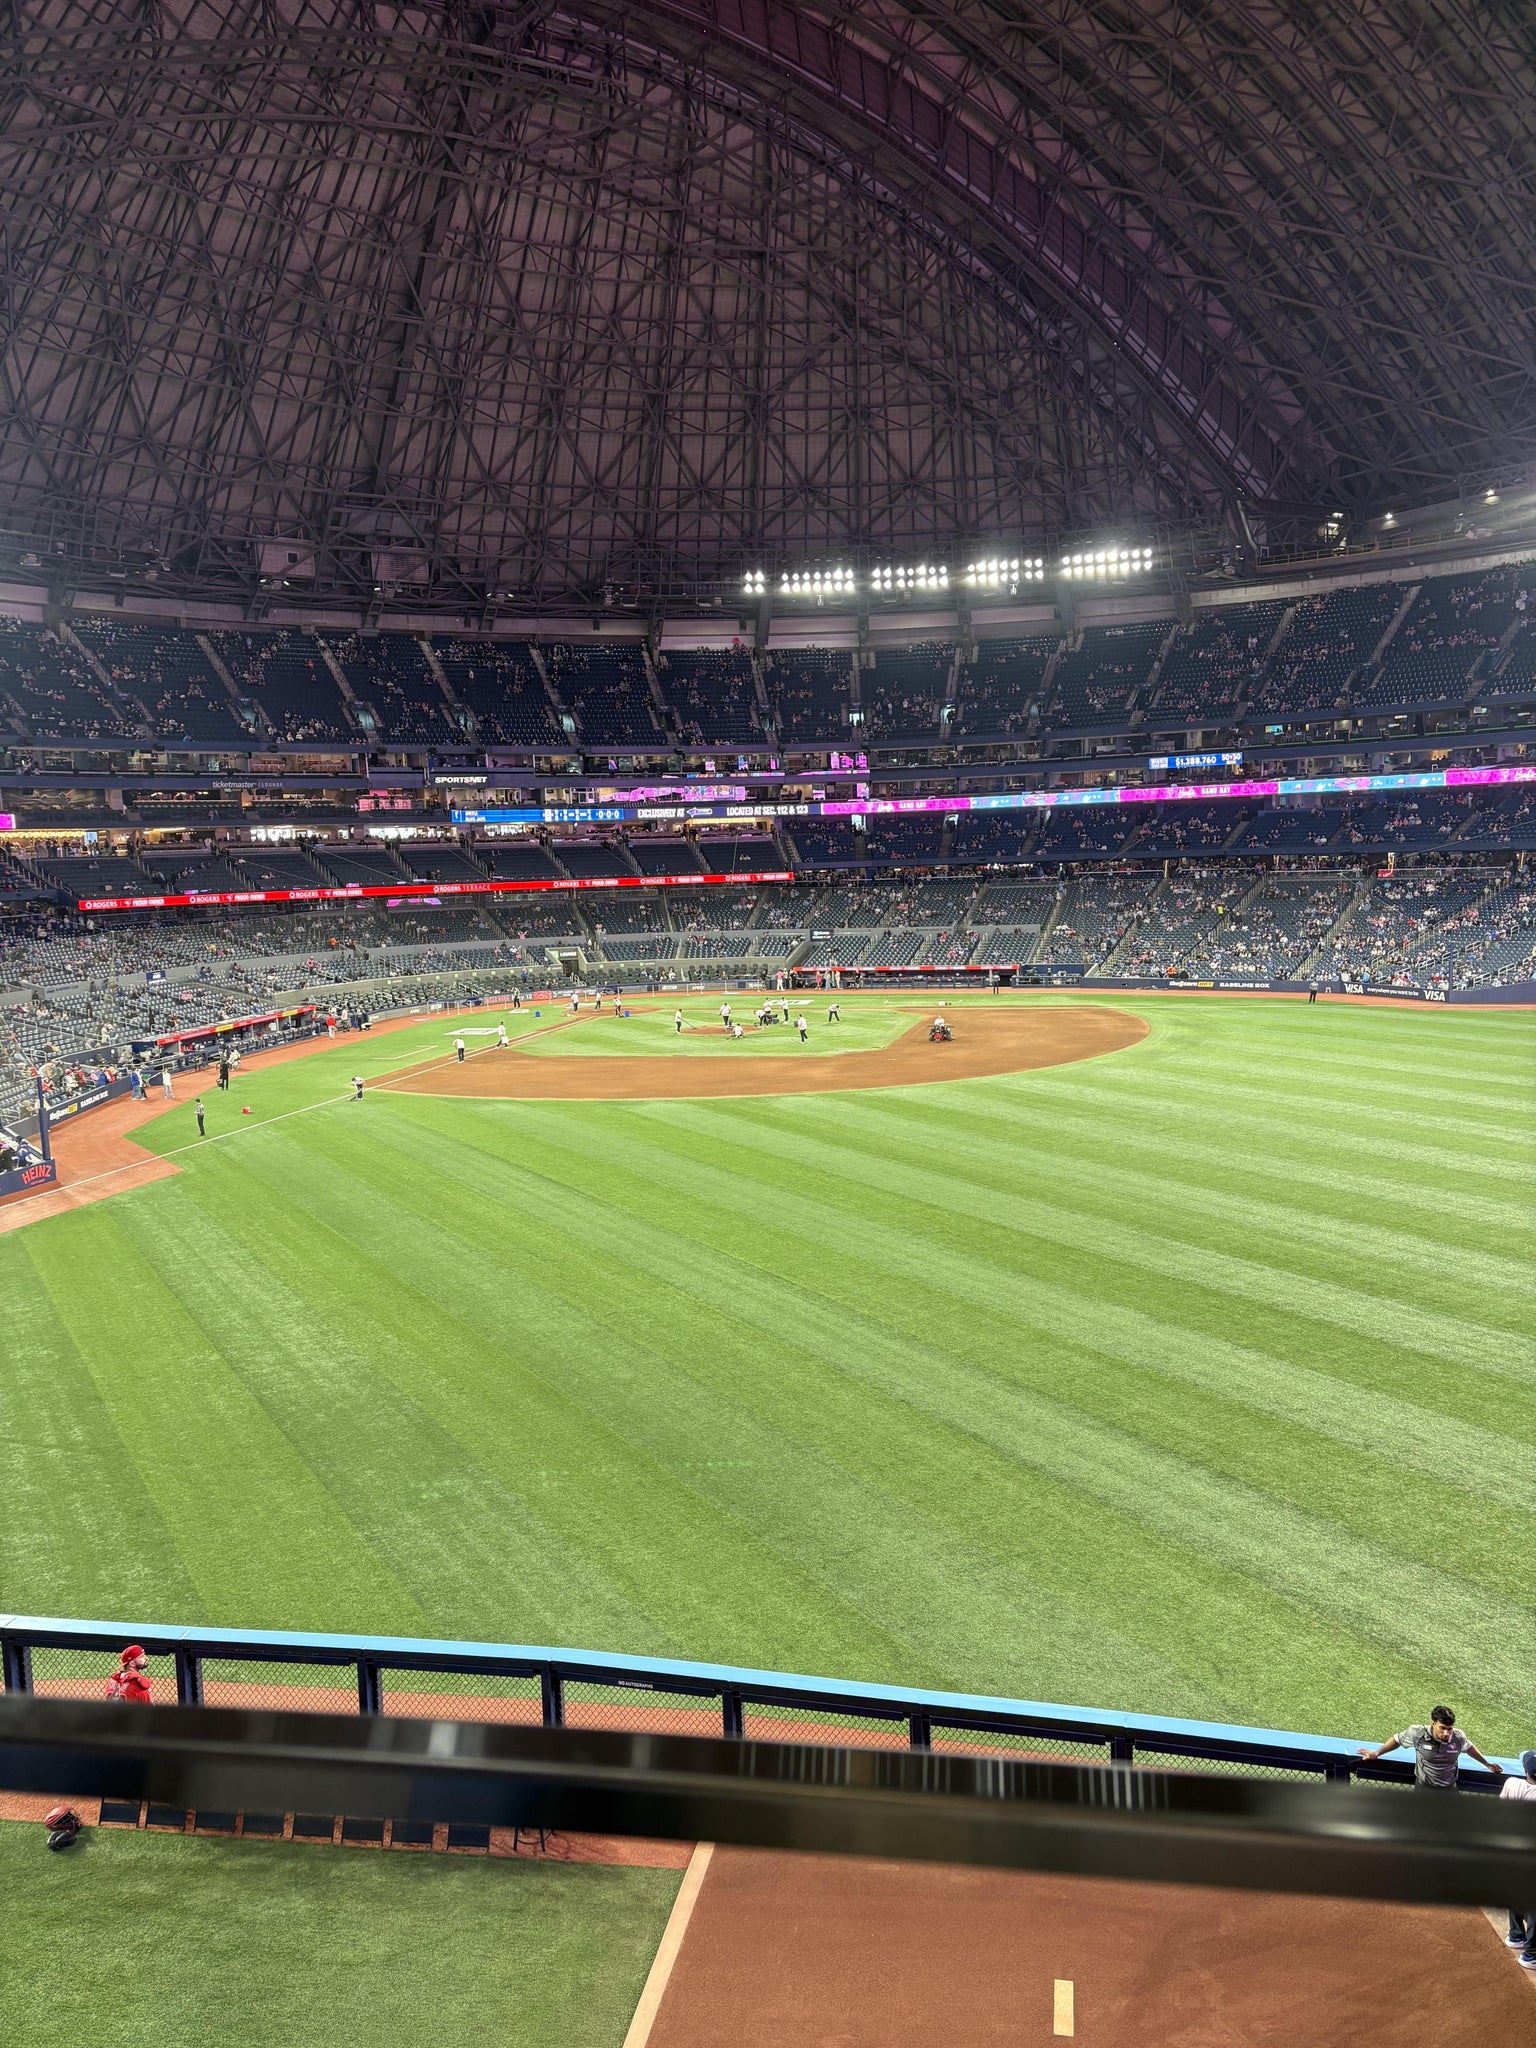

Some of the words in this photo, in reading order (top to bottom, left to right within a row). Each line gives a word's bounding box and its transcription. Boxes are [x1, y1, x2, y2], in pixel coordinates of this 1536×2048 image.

[212, 780, 255, 788] ticketmaster
[435, 776, 488, 784] SPORTSNET
[637, 808, 676, 818] EXCLUSIVELY
[677, 808, 685, 818] AT
[726, 806, 753, 816] LOCATED
[754, 806, 762, 816] AT
[762, 805, 777, 816] SEC.
[777, 805, 788, 815] 112
[788, 805, 796, 815] &
[796, 804, 809, 815] 123
[1344, 983, 1364, 994] VISA
[1366, 987, 1390, 995] everywhere
[1423, 990, 1446, 1001] VISA
[80, 1095, 100, 1108] BASELINE
[99, 1090, 109, 1099] BOX
[21, 1165, 52, 1185] HEINZ
[625, 1681, 654, 1689] AUTOGRAPHS
